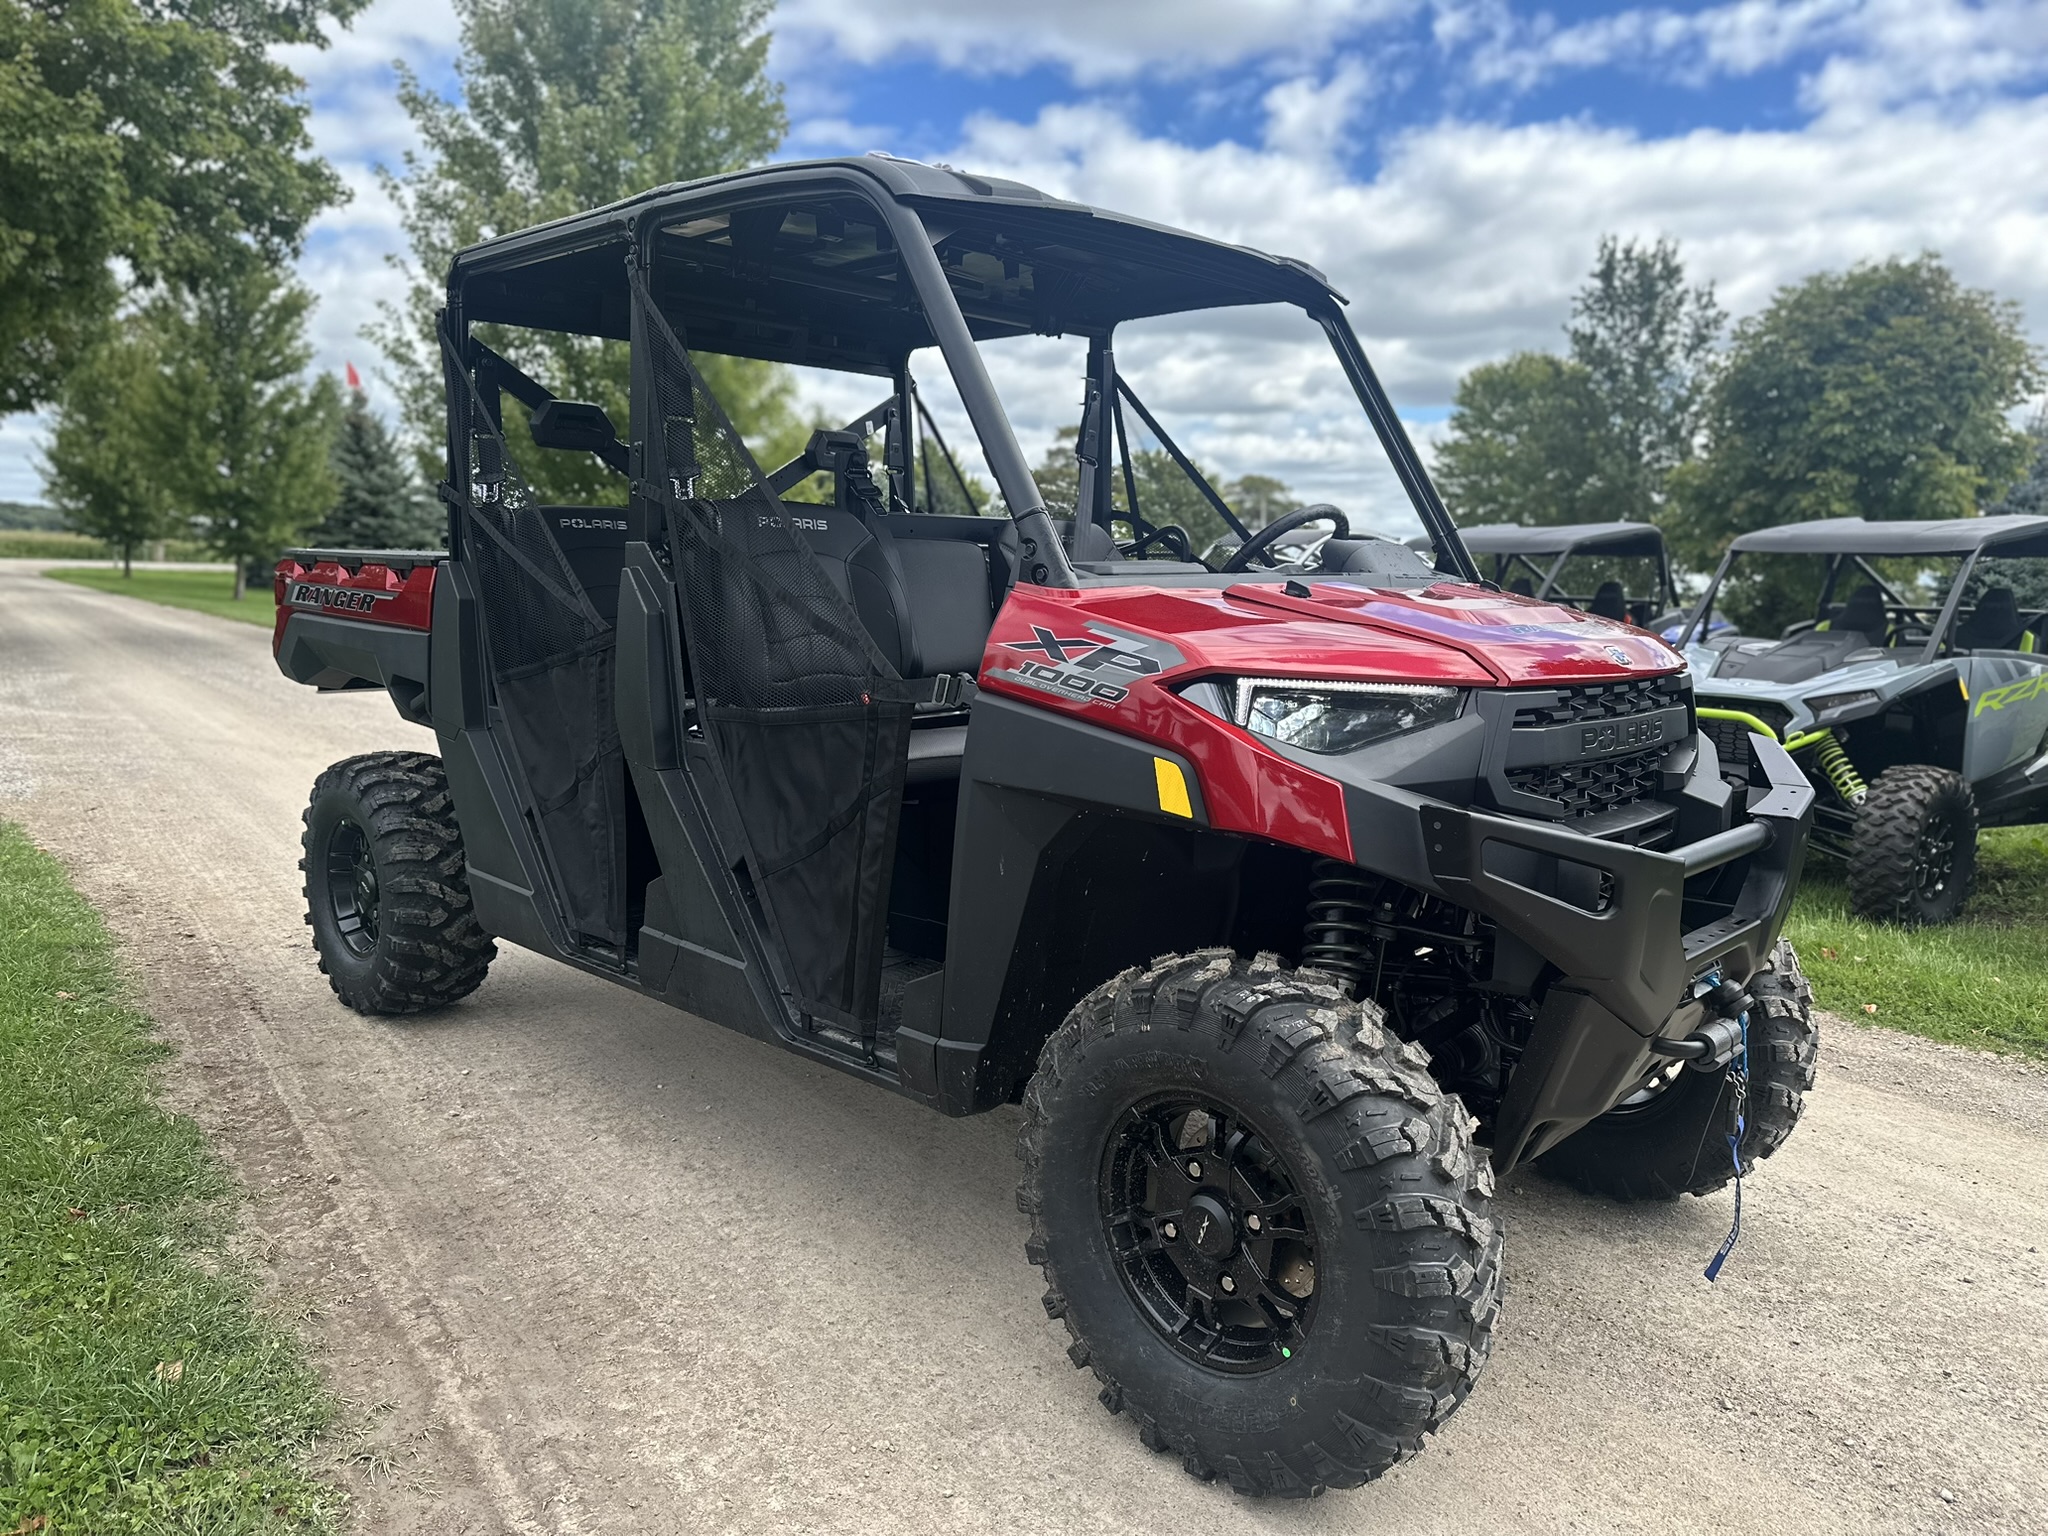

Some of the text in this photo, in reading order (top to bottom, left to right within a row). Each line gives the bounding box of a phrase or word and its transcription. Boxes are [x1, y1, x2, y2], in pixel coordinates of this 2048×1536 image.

[559, 518, 628, 531] POLARIS
[294, 584, 376, 613] RANGER
[995, 624, 1163, 676] XP
[1014, 676, 1116, 710] DUAL OVERHEAD CAM
[1018, 659, 1130, 704] 1000
[1581, 716, 1663, 755] POLARIS
